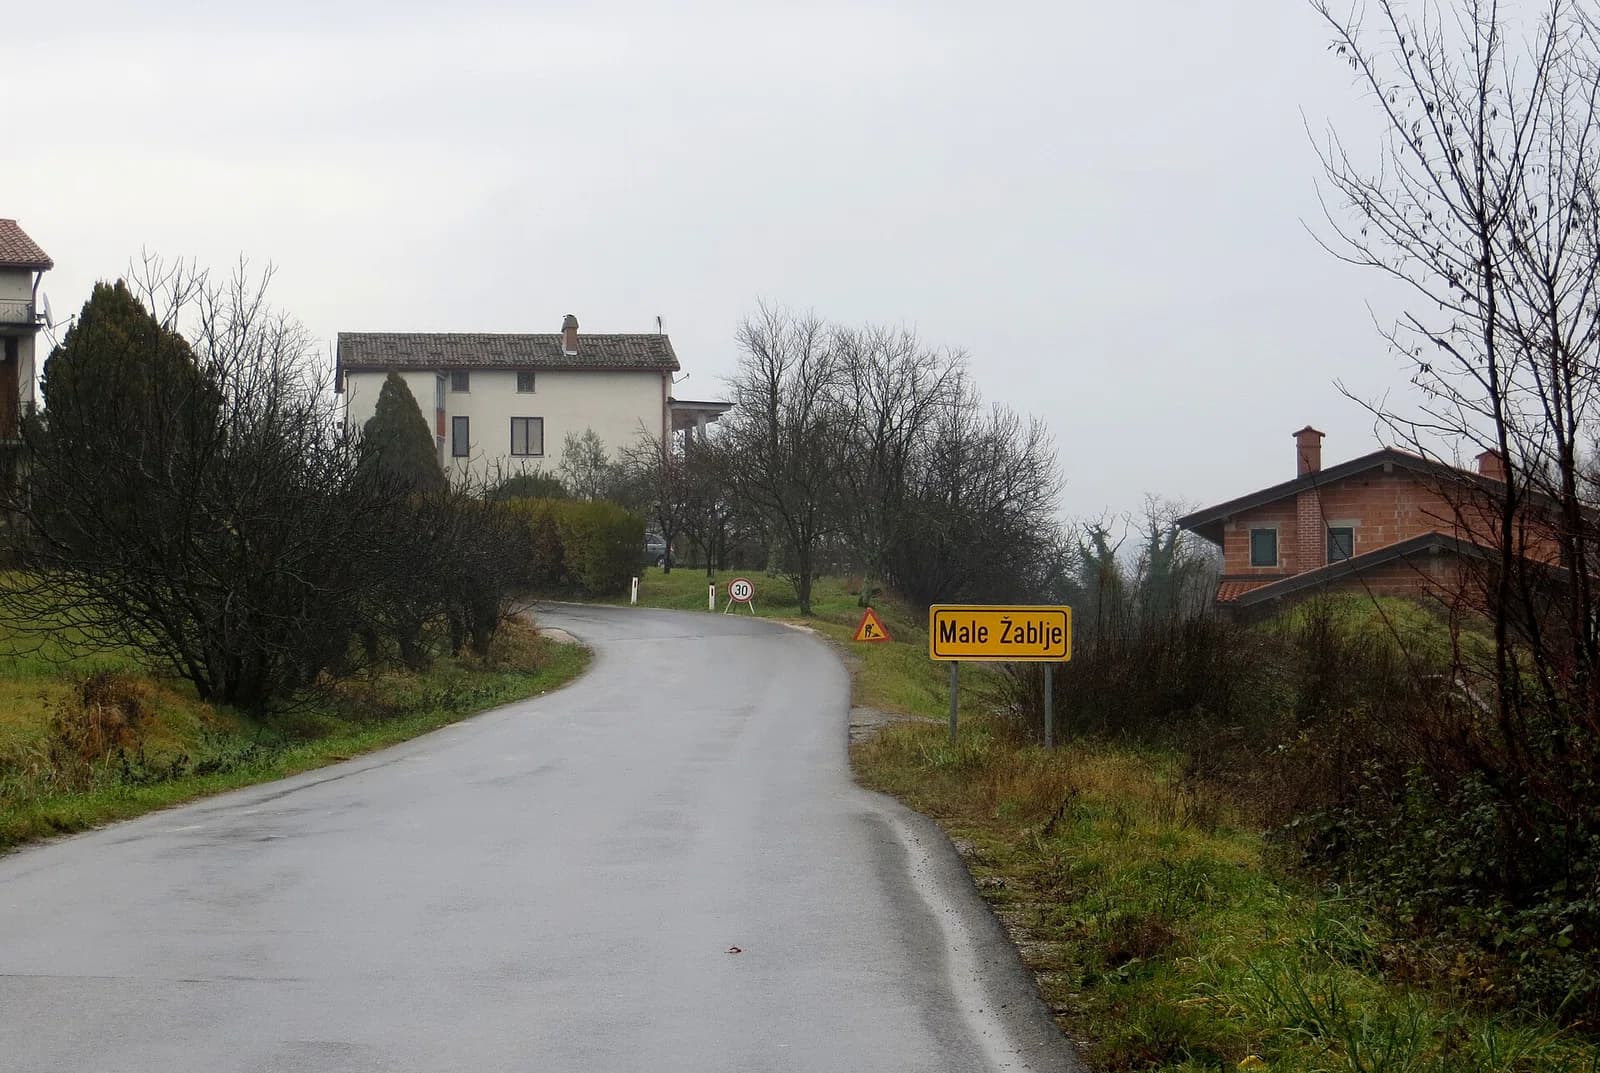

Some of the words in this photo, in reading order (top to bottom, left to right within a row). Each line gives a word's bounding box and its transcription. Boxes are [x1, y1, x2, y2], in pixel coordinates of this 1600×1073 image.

[734, 584, 748, 597] 30
[939, 619, 989, 644] Male
[999, 615, 1063, 651] Žablje
